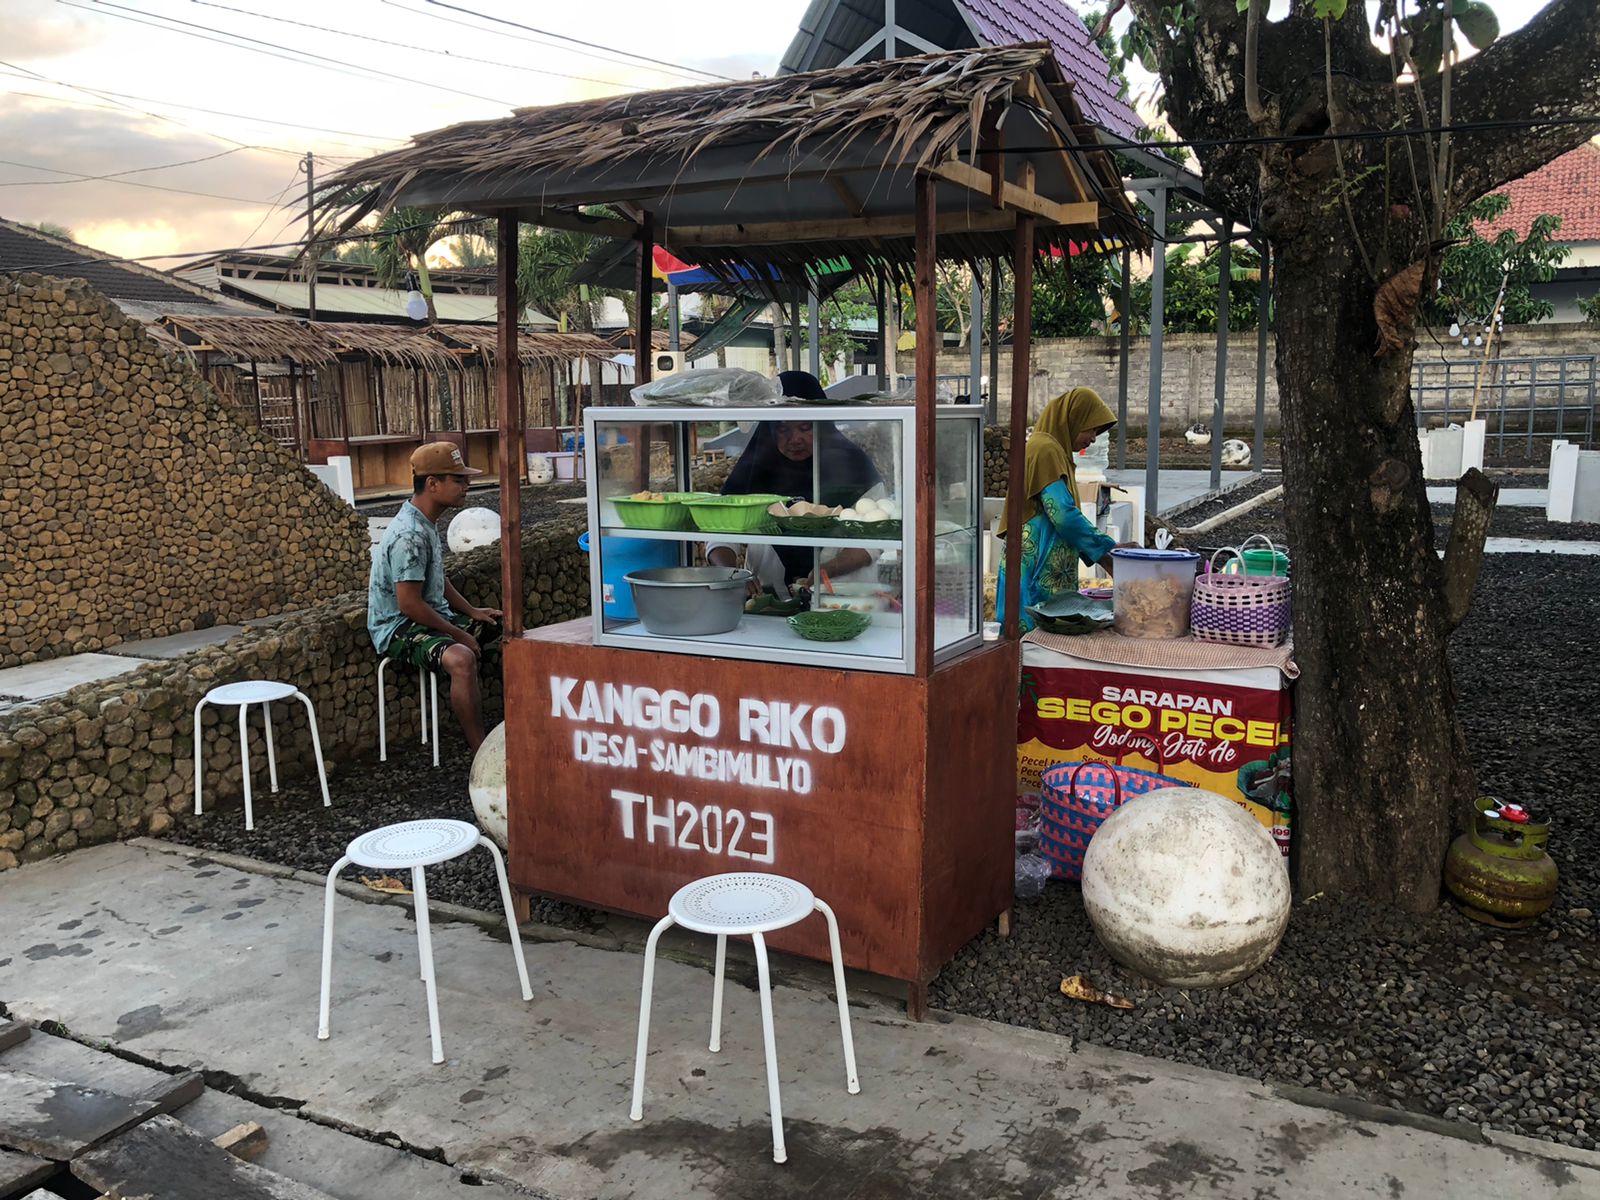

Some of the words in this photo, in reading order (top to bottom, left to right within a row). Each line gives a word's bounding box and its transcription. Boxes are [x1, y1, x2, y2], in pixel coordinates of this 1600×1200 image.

[550, 676, 720, 737] KANGGO
[739, 698, 846, 753] RIKO
[1102, 686, 1232, 716] SARAPAN
[1037, 697, 1151, 729] SEGO
[1160, 709, 1288, 746] PECEL
[1021, 756, 1048, 767] Pecel
[1163, 731, 1207, 760] Jati
[1208, 739, 1236, 763] Ae
[1021, 767, 1043, 777] Pece
